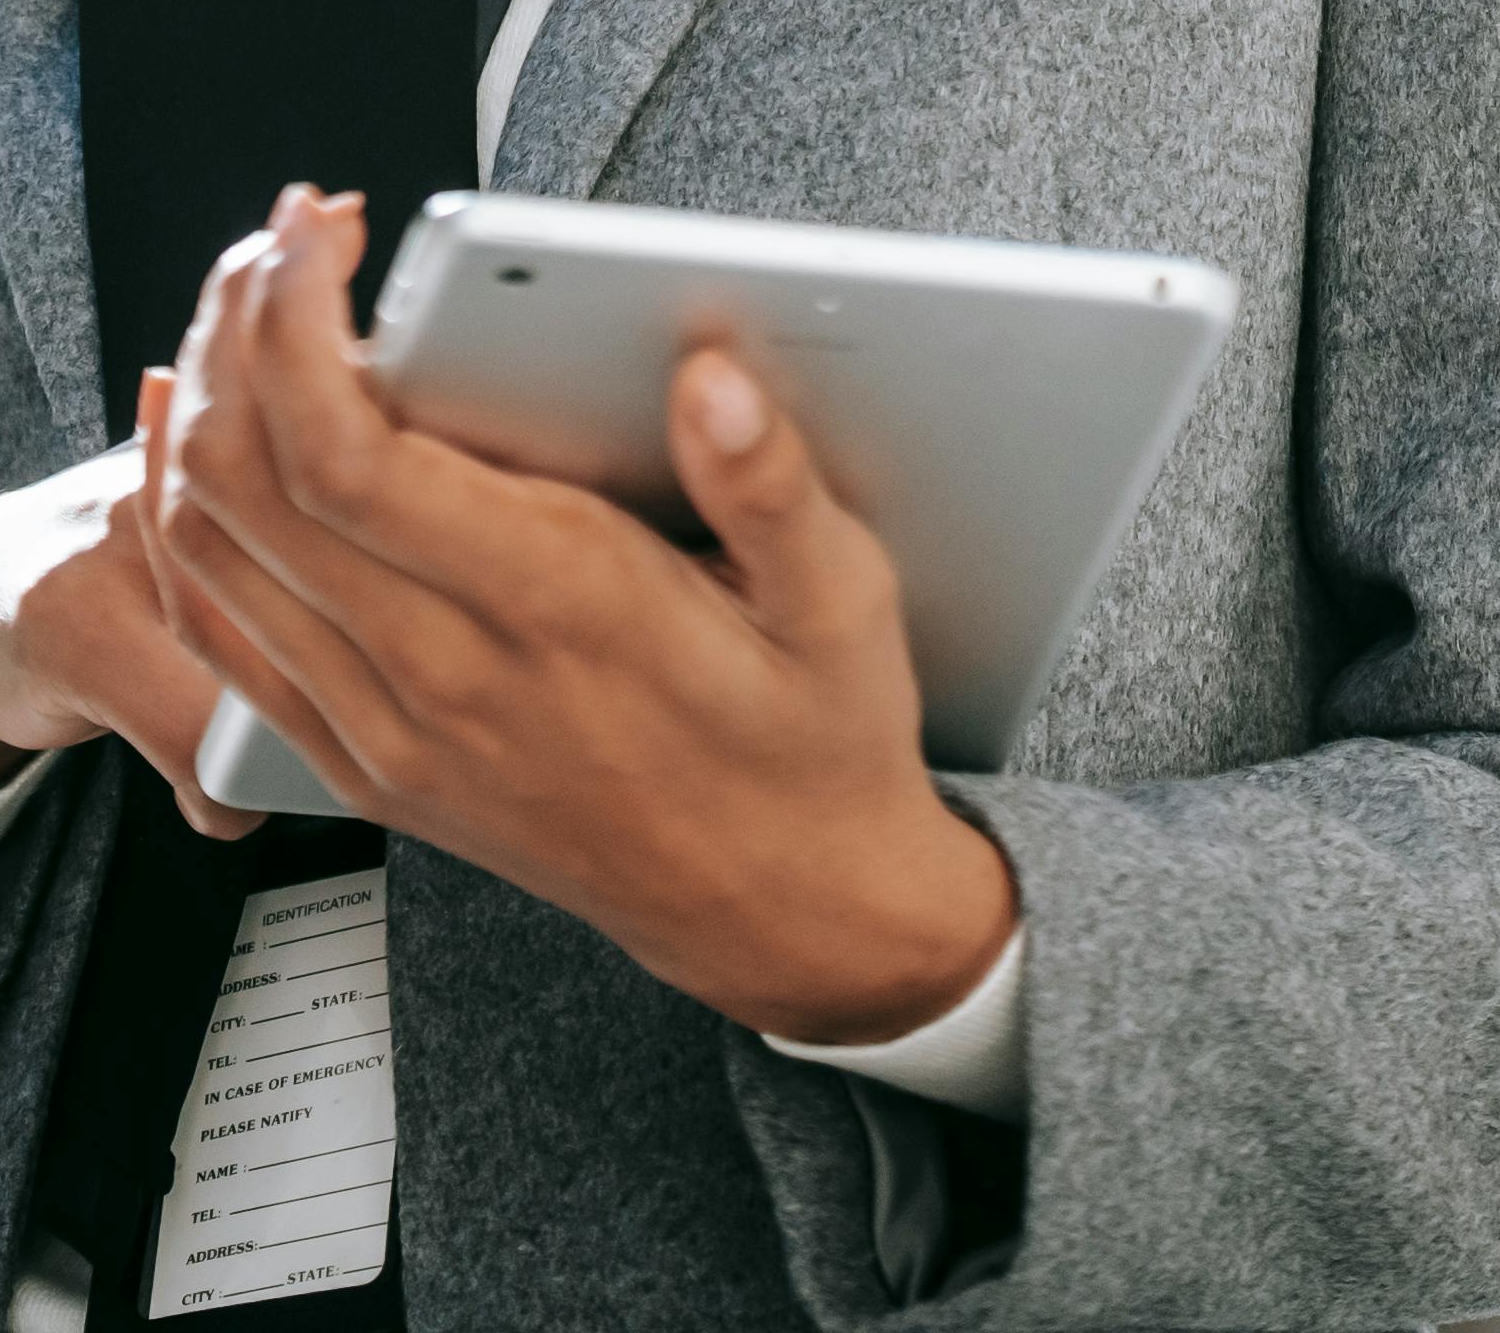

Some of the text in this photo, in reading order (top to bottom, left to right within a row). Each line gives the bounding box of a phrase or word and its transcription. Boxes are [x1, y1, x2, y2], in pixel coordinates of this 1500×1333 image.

[262, 889, 372, 926] IDENTIFICATION
[210, 990, 363, 1034] CITY: STATE:
[204, 1054, 386, 1106] IN CASE OF EMERGENCY
[207, 1055, 237, 1071] TEL:
[200, 1107, 313, 1143] PLEASE NATIFY
[195, 1163, 238, 1184] NAME
[191, 1208, 221, 1224] TEL:
[186, 1240, 258, 1266] ADDRESS:
[181, 1288, 216, 1307] CITY
[286, 1265, 340, 1286] STATE:
